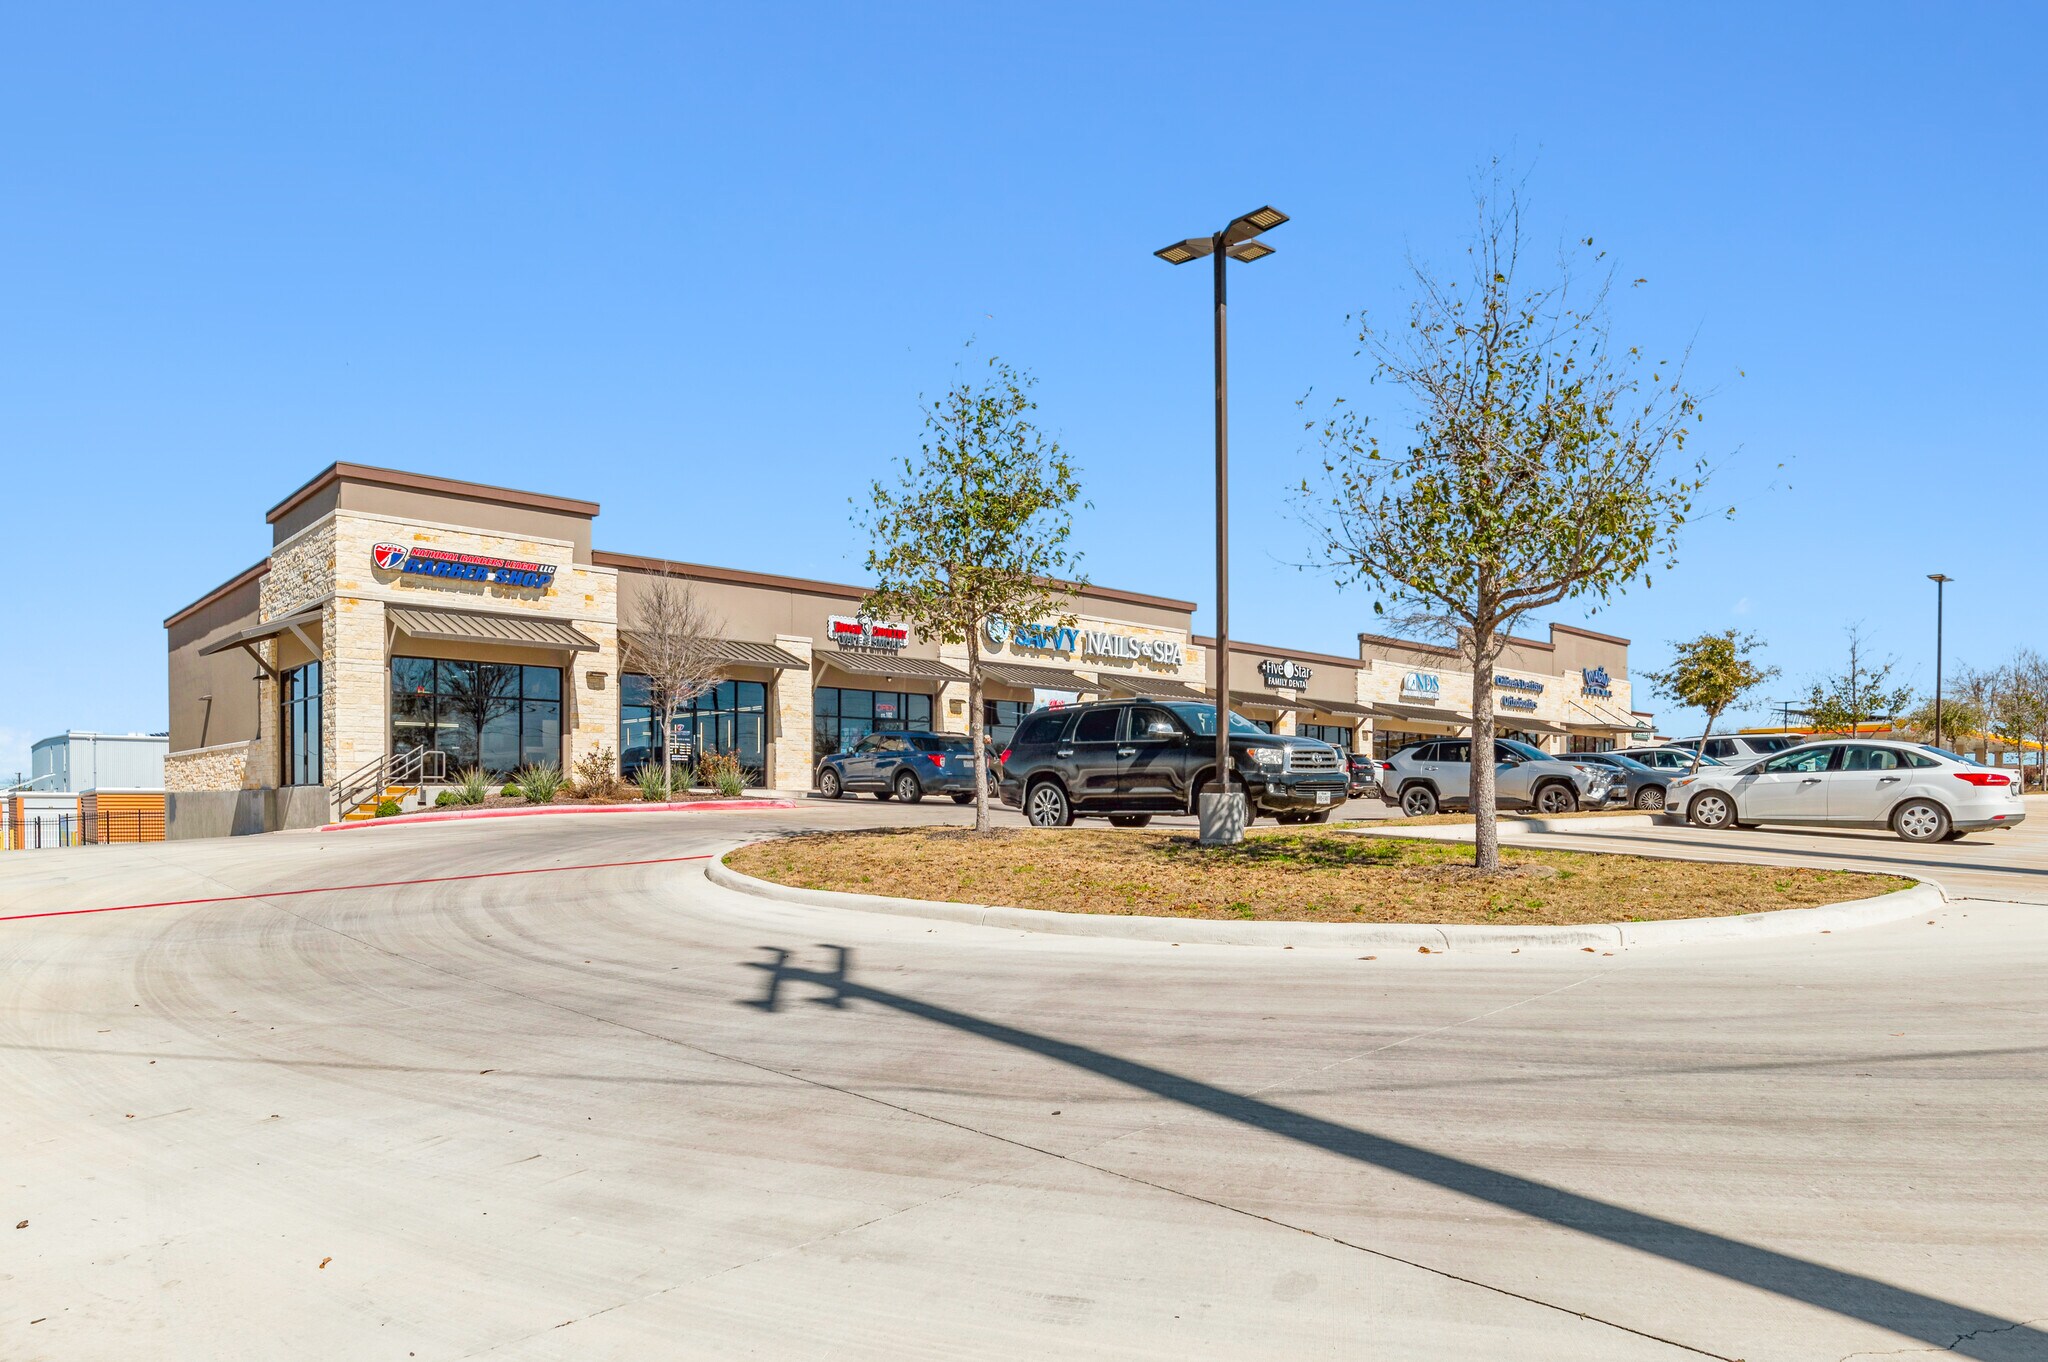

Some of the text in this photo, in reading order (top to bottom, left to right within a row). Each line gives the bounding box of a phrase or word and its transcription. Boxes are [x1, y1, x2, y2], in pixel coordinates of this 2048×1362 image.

[403, 558, 552, 589] BARBER SHOP
[411, 548, 556, 574] NATIONAL BARBERS LEAGUE LLC
[1084, 630, 1140, 660] NAILS
[1140, 641, 1152, 656] &
[1152, 640, 1183, 666] SPA
[1266, 661, 1310, 678] Five Star
[1268, 677, 1308, 688] FAMILY DENTAL
